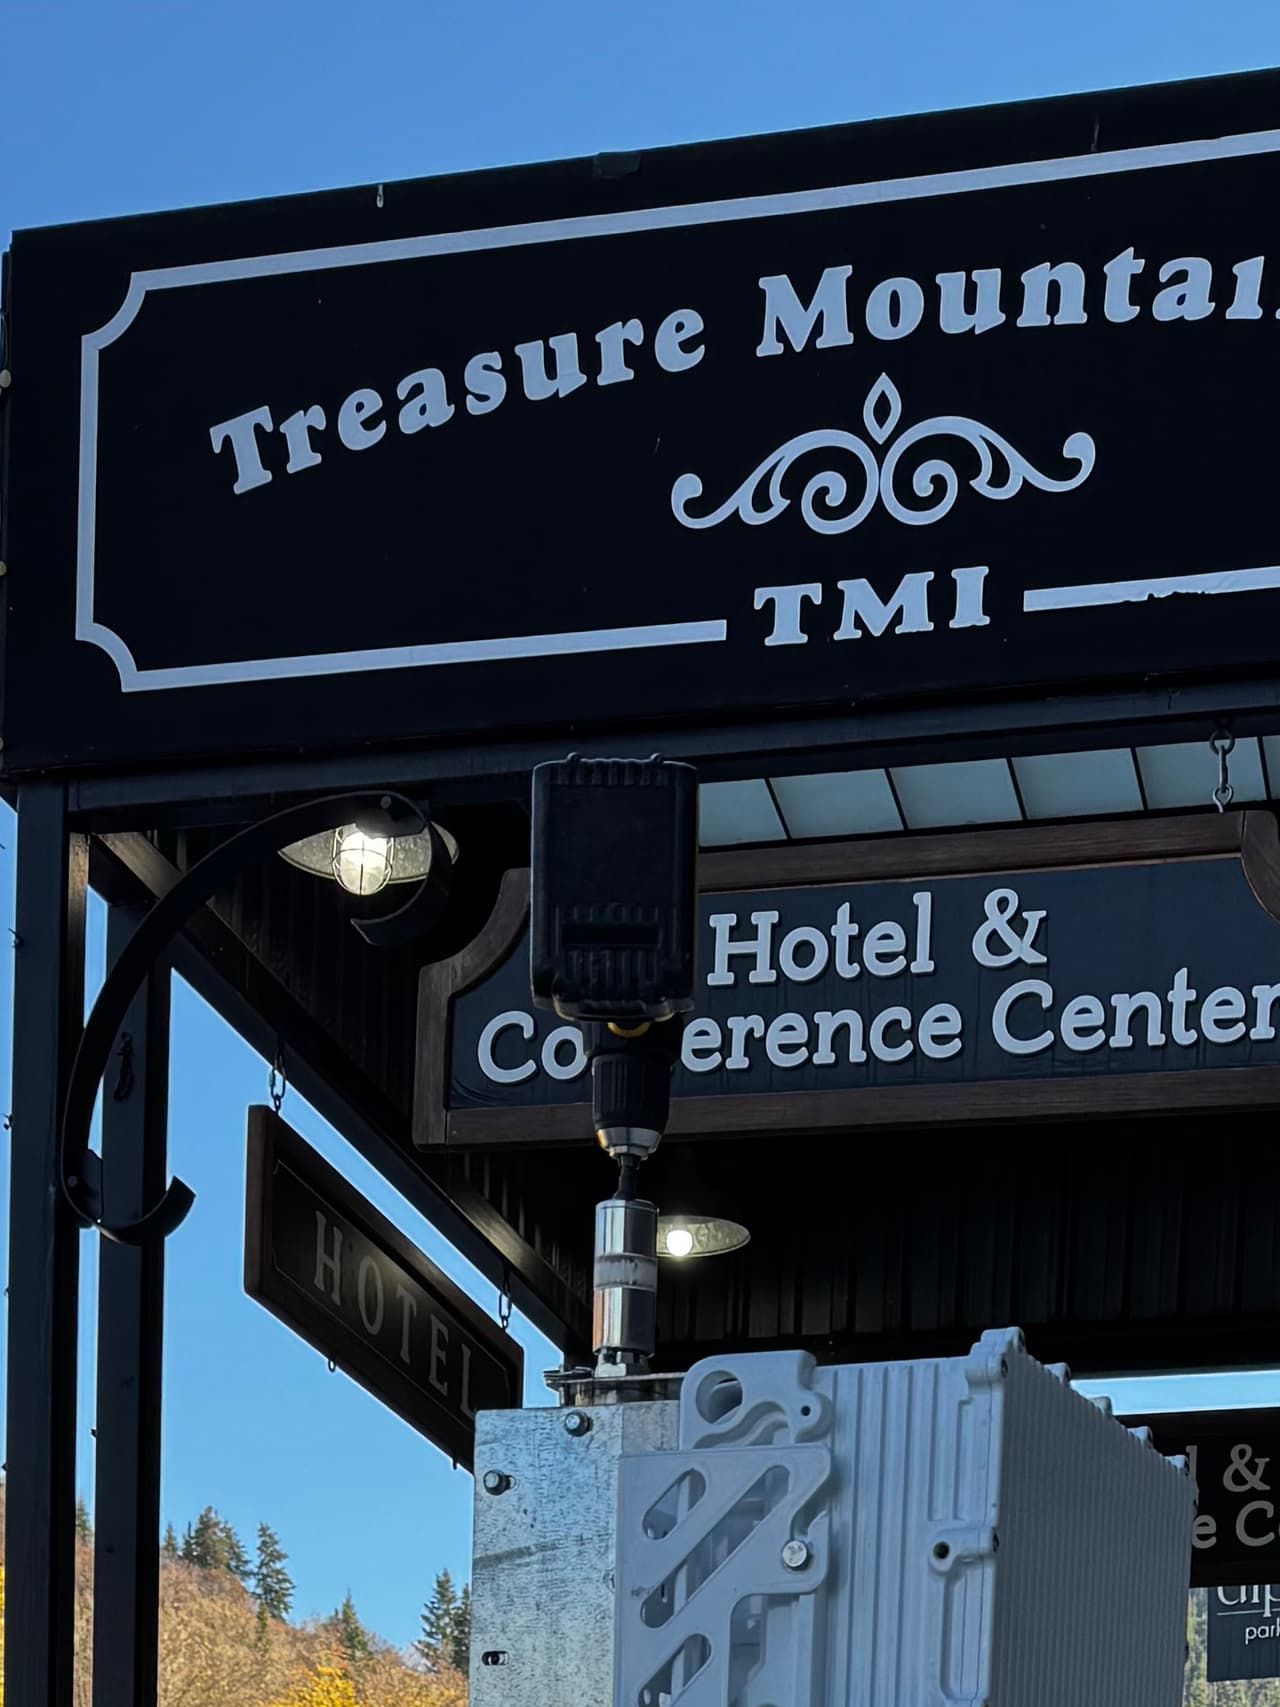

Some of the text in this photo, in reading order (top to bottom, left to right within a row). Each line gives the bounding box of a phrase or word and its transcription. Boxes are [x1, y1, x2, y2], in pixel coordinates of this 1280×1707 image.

[209, 308, 706, 495] Treasure
[753, 565, 991, 647] TMI
[706, 888, 1048, 986] Hotel &
[477, 1003, 962, 1083] Coerence
[314, 1210, 477, 1421] HOTEL
[1222, 1443, 1271, 1493] &
